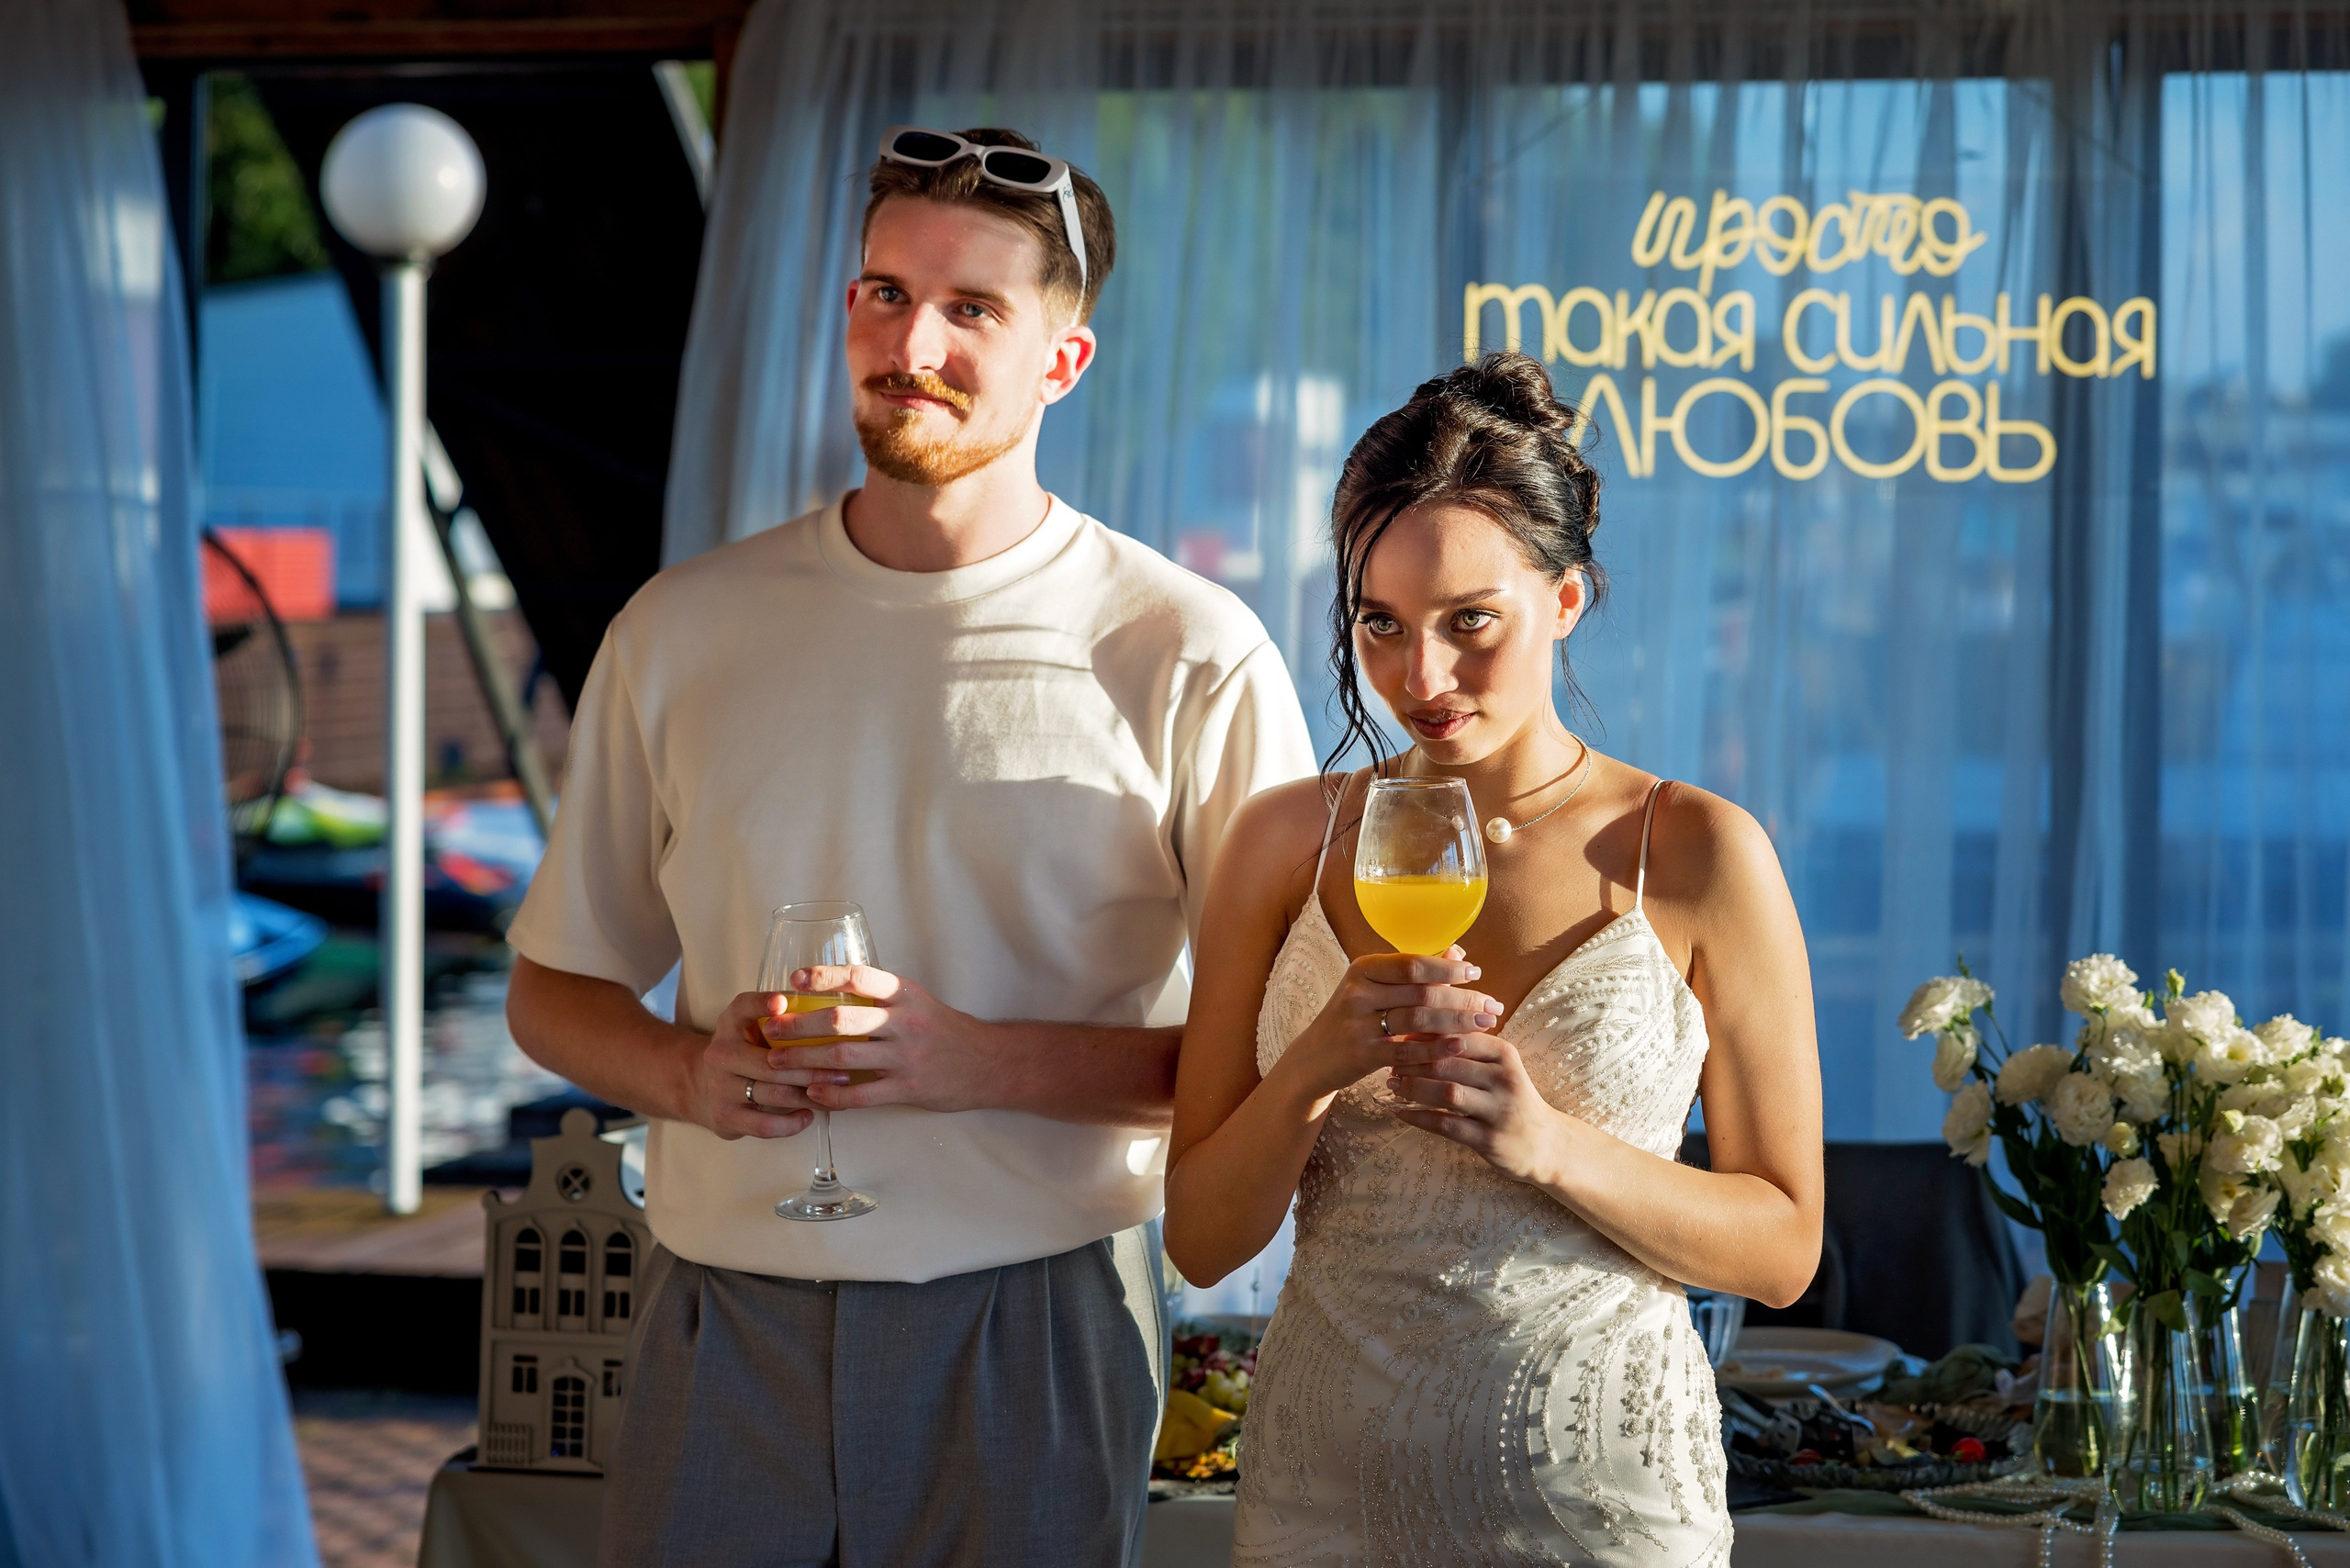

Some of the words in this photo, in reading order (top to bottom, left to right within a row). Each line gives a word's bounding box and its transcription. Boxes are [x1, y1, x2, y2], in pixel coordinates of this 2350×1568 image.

[1631, 187, 1988, 297] просто
[1463, 281, 1756, 373] такая
[1783, 287, 2156, 380] сильная
[1569, 373, 2057, 483] ЛЮБОВЬ
